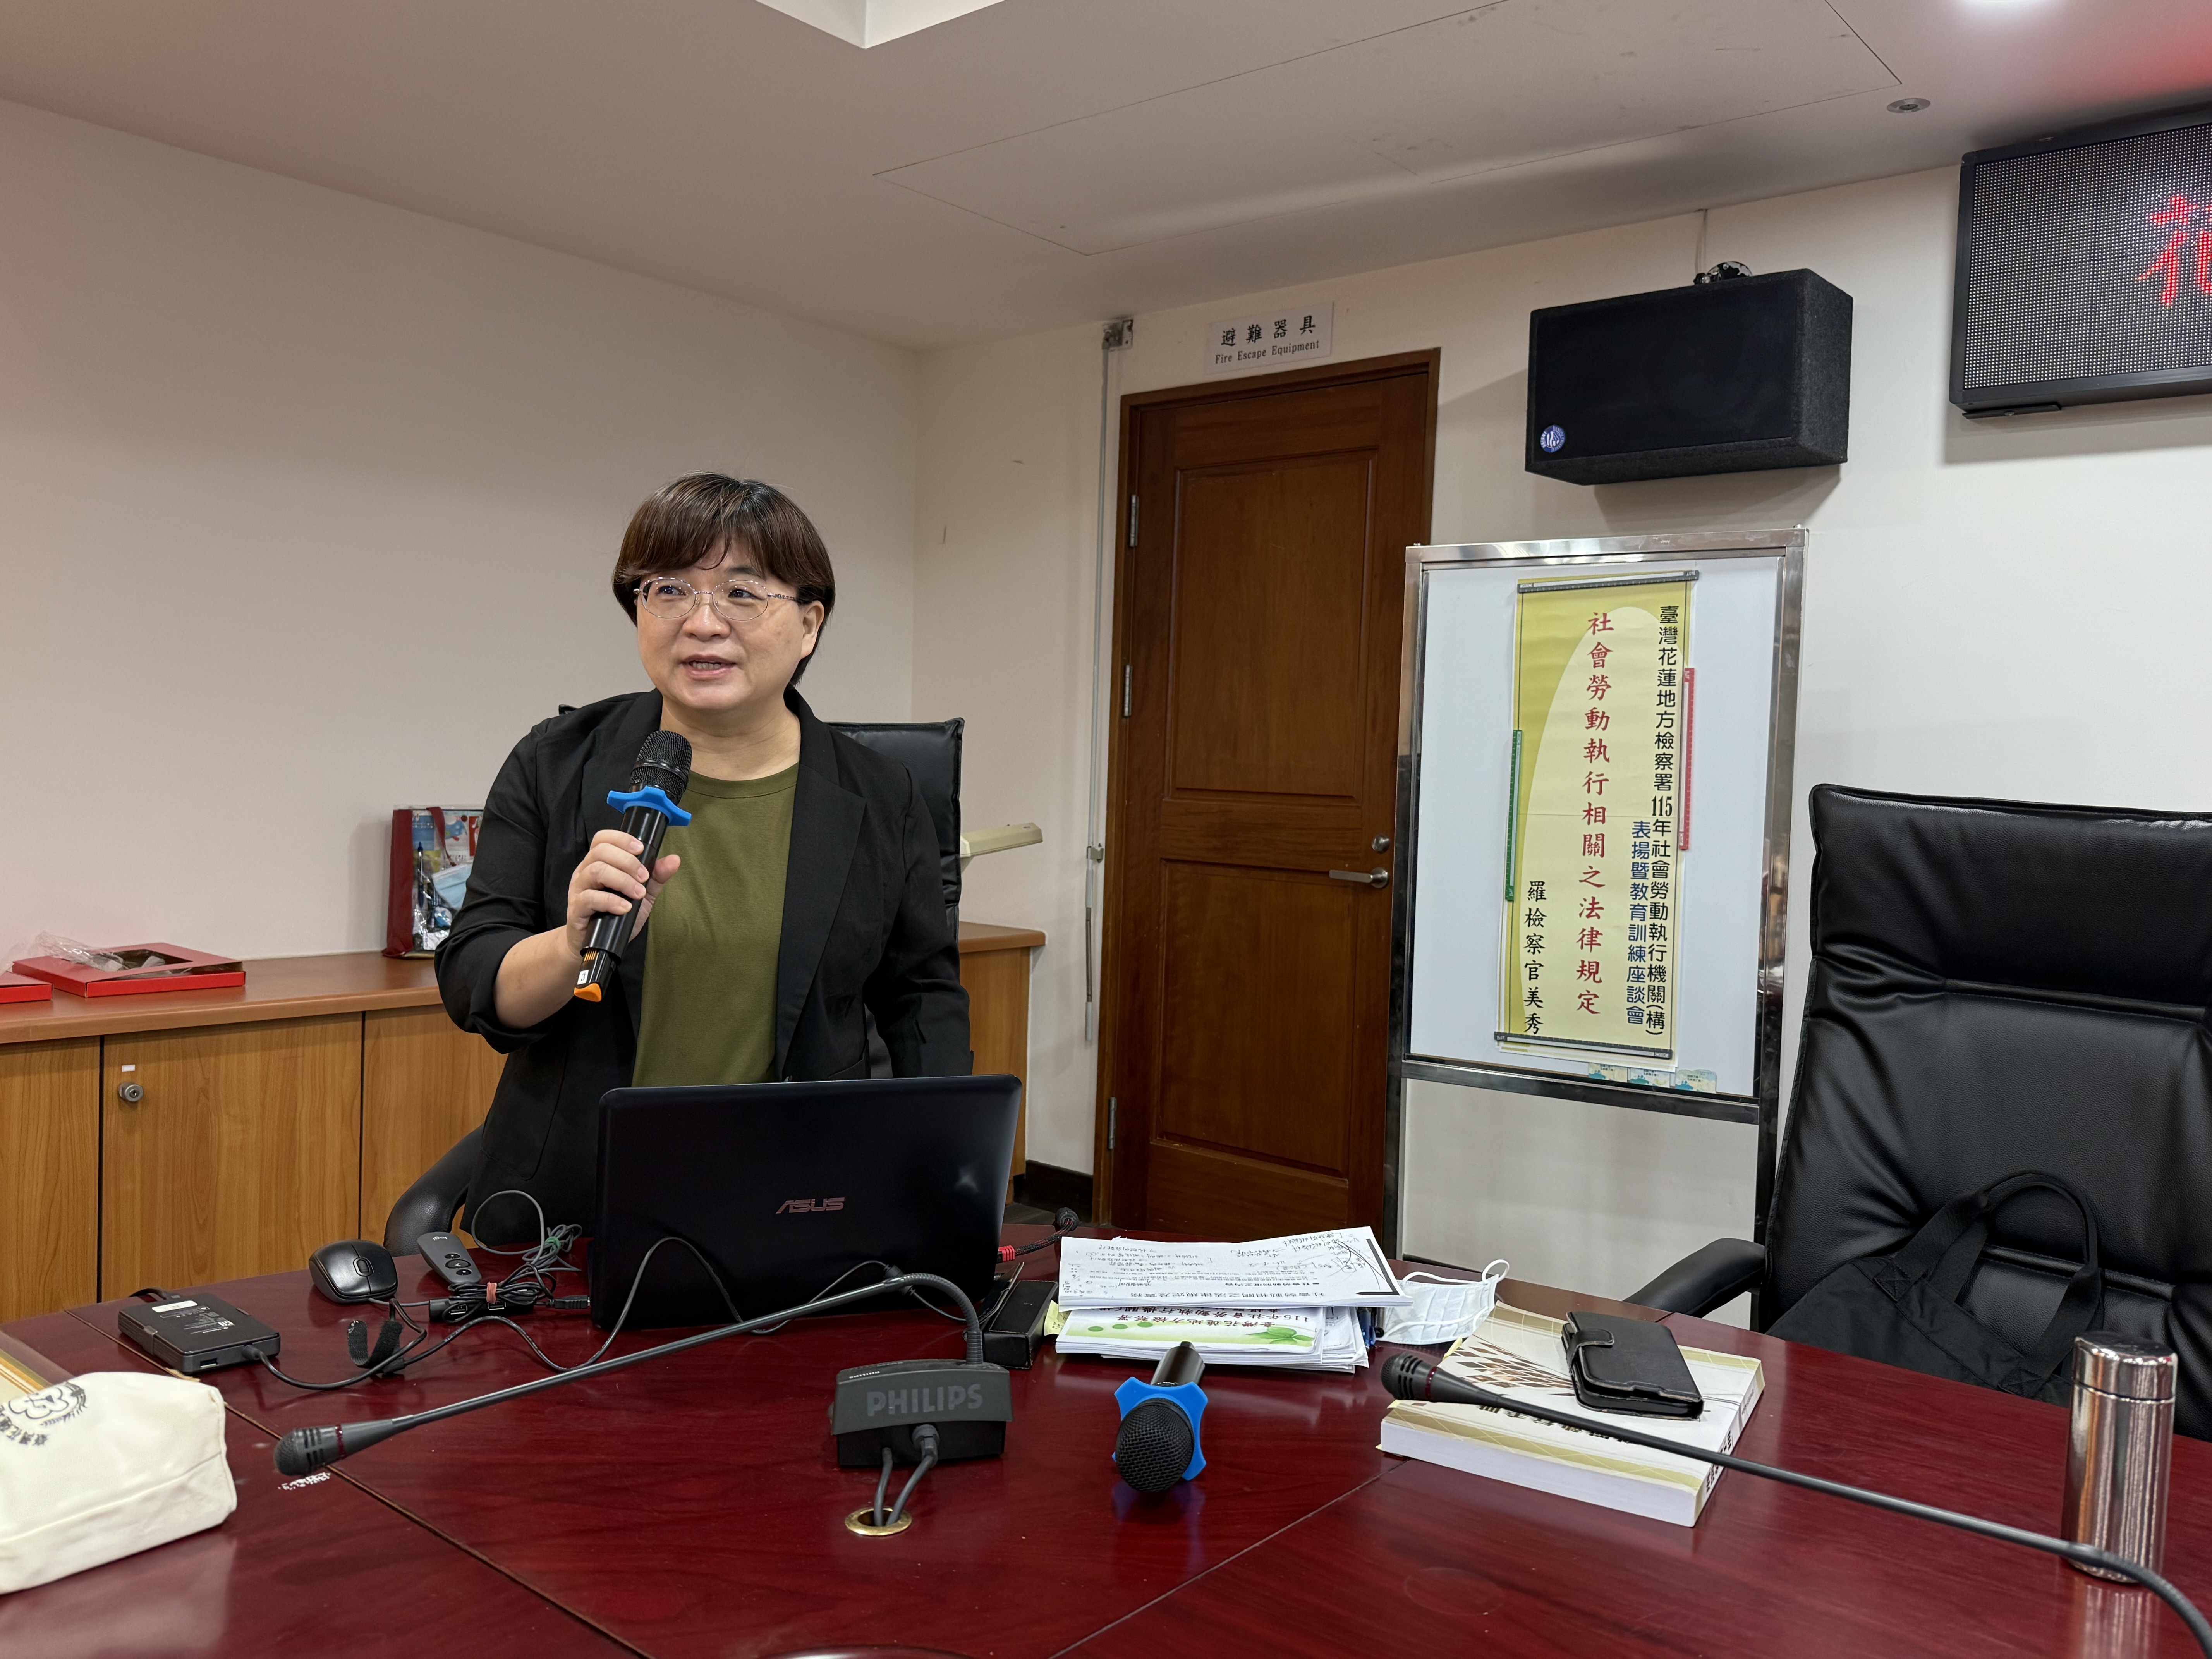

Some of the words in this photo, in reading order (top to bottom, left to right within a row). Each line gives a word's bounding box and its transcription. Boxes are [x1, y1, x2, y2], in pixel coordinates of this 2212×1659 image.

[1221, 315, 1316, 347] 避難器具
[1215, 354, 1233, 364] Fire
[1237, 349, 1267, 361] Escape
[1272, 339, 1320, 356] Equipment
[1576, 612, 1614, 1015] 社會勞動執行相關之法律規定
[1646, 605, 1679, 1036] 臺灣花蓮地方檢察署115年社會勞動執行機關(構)
[1626, 820, 1651, 1025] 表揚暨教育訓練座談會
[1523, 880, 1547, 1035] 羅檢察官美秀
[581, 972, 586, 981] 3
[776, 1197, 845, 1214] ASUS
[866, 1384, 983, 1417] PHILIPS
